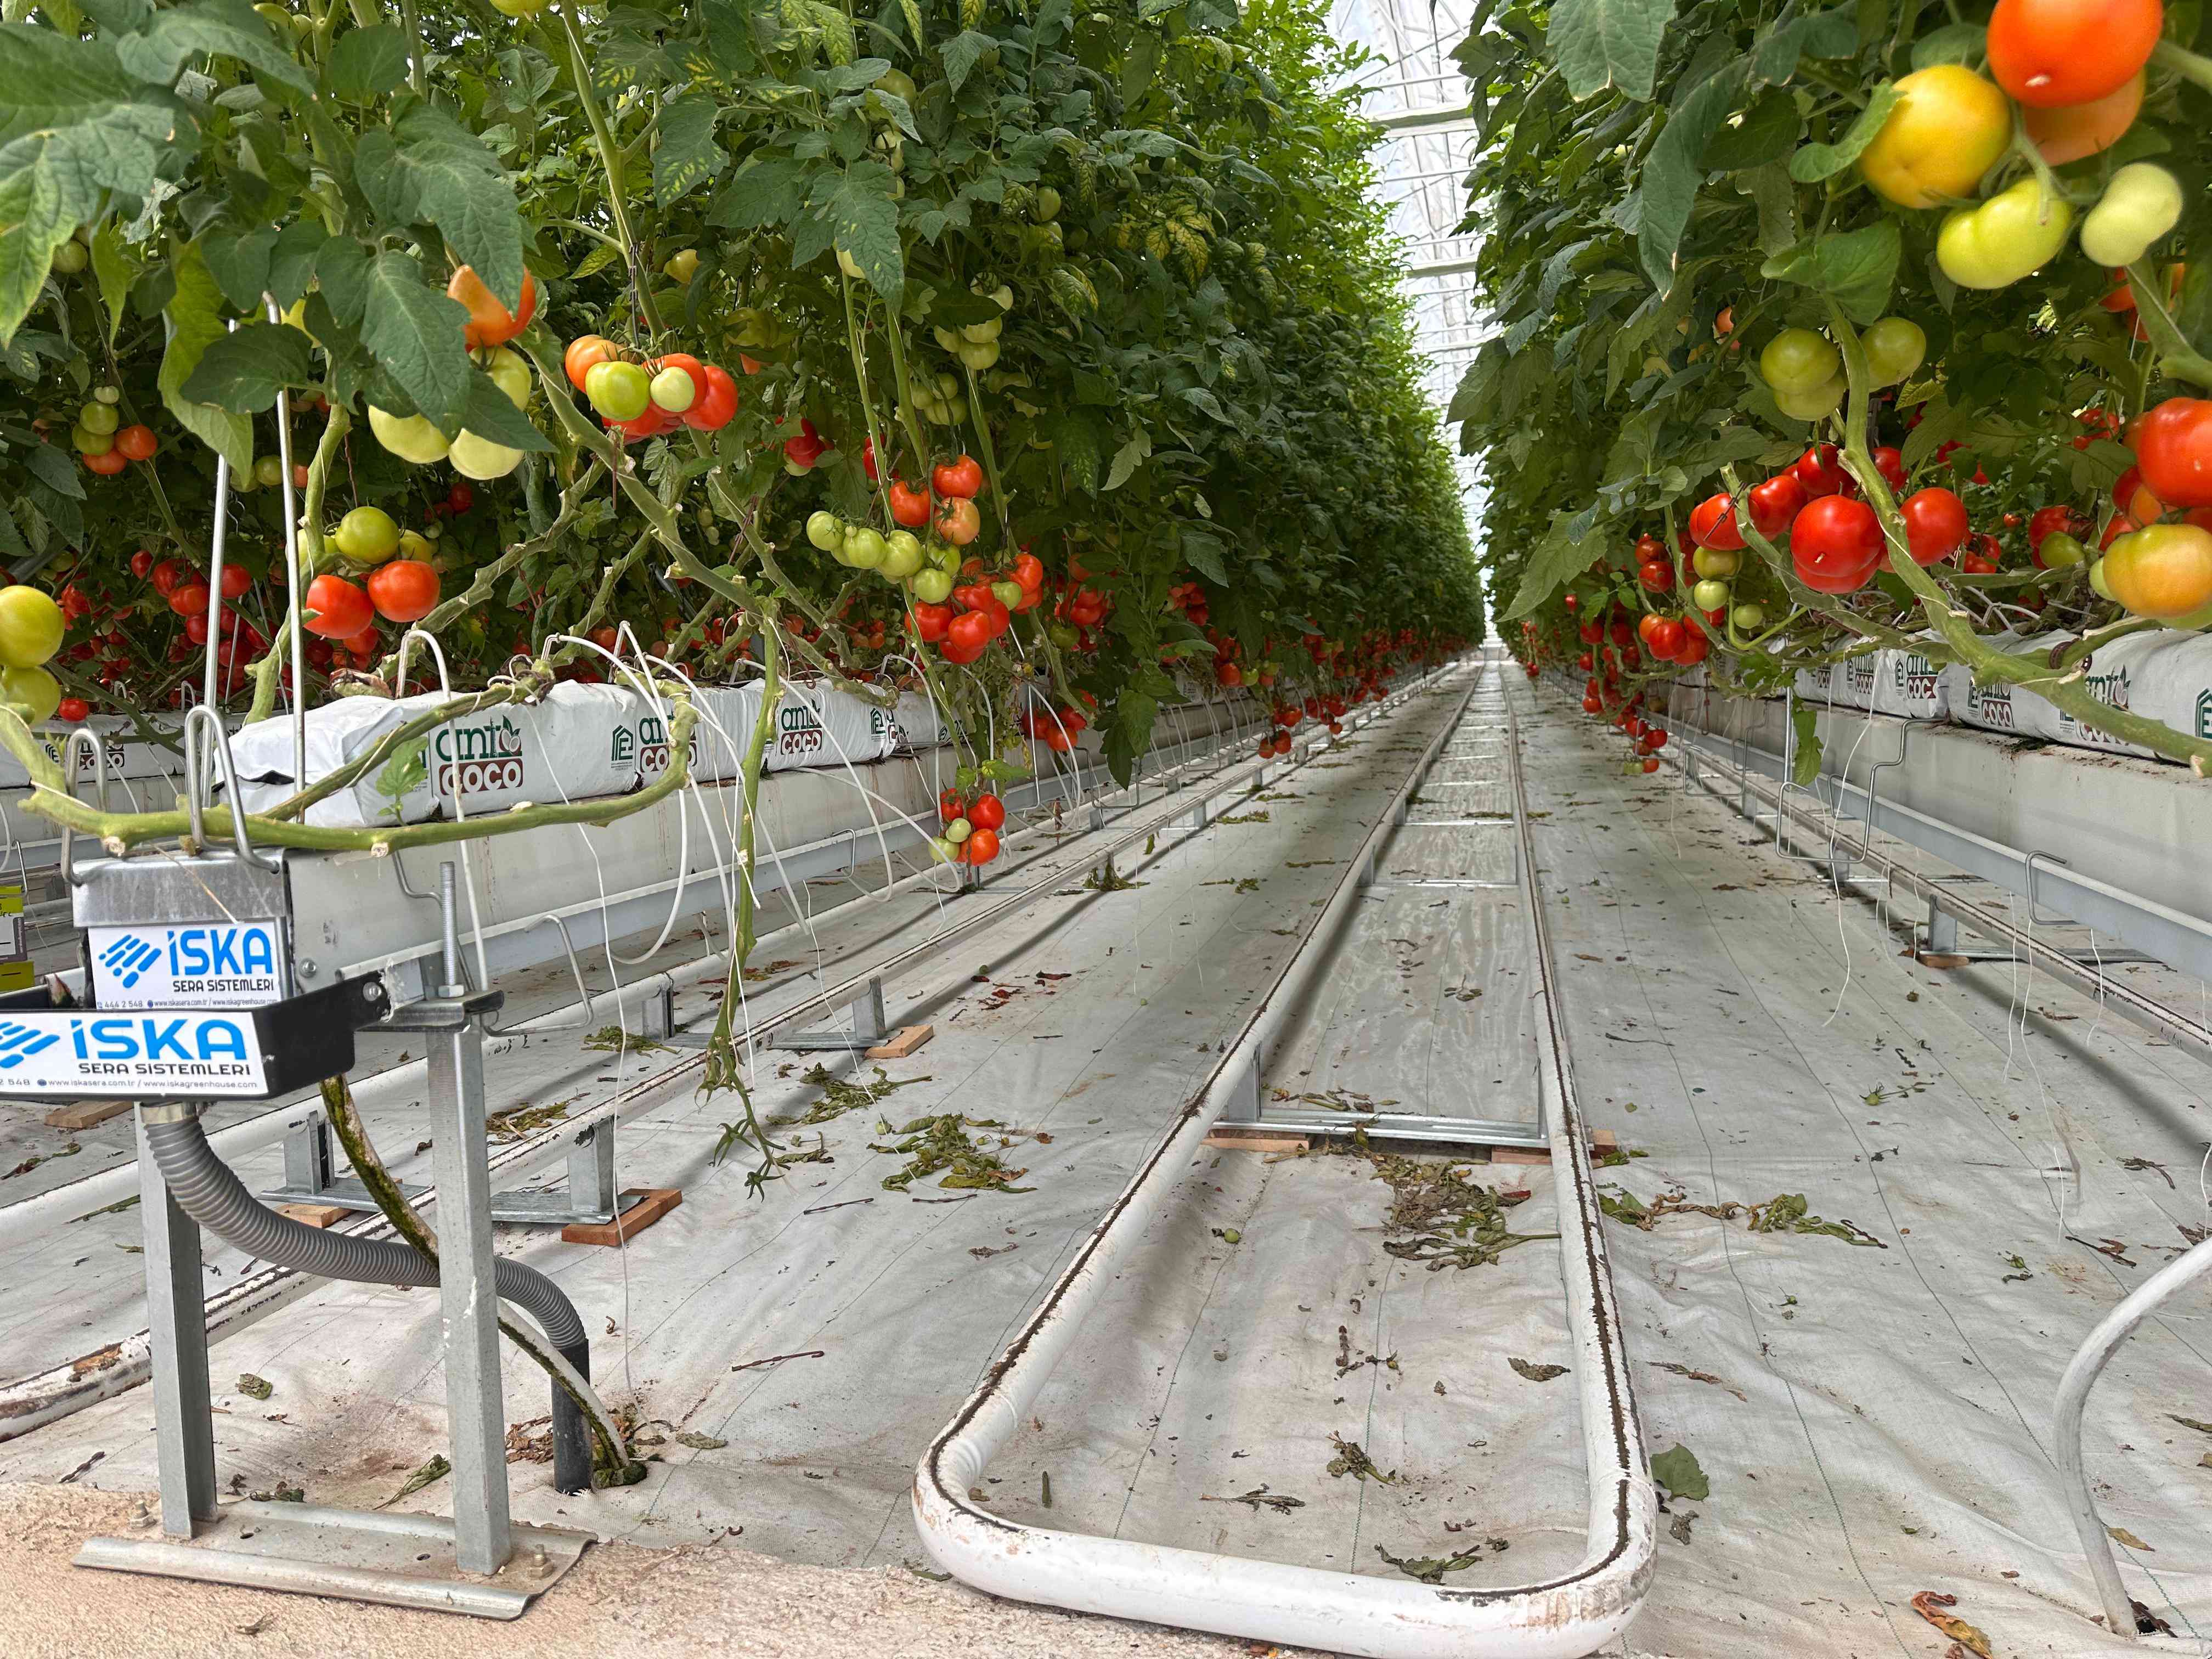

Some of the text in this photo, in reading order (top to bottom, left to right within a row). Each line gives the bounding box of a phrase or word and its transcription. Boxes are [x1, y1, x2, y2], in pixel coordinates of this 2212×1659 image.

[1983, 702, 2011, 727] coco
[782, 731, 822, 755] coco
[173, 979, 204, 993] SERA
[78, 1063, 129, 1074] SERA
[48, 1079, 134, 1087] www.iskasera.com.tr
[143, 1080, 257, 1089] www.iskagreenhouse.com
